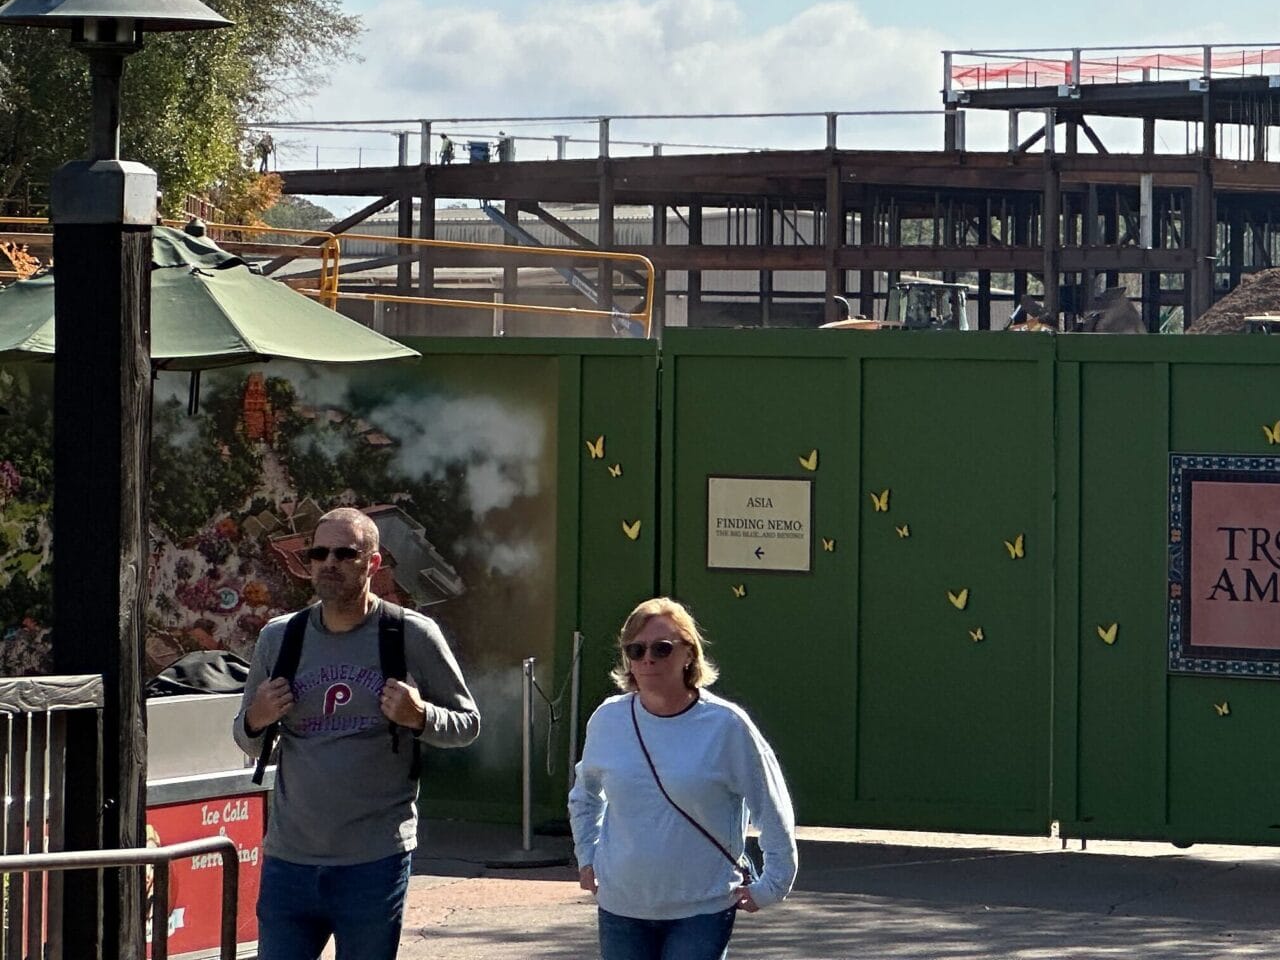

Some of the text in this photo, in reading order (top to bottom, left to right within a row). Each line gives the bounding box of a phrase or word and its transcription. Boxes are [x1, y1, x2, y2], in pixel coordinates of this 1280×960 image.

[746, 497, 773, 508] ASIA
[716, 517, 764, 530] FINDING
[202, 800, 249, 825] Ice Cold
